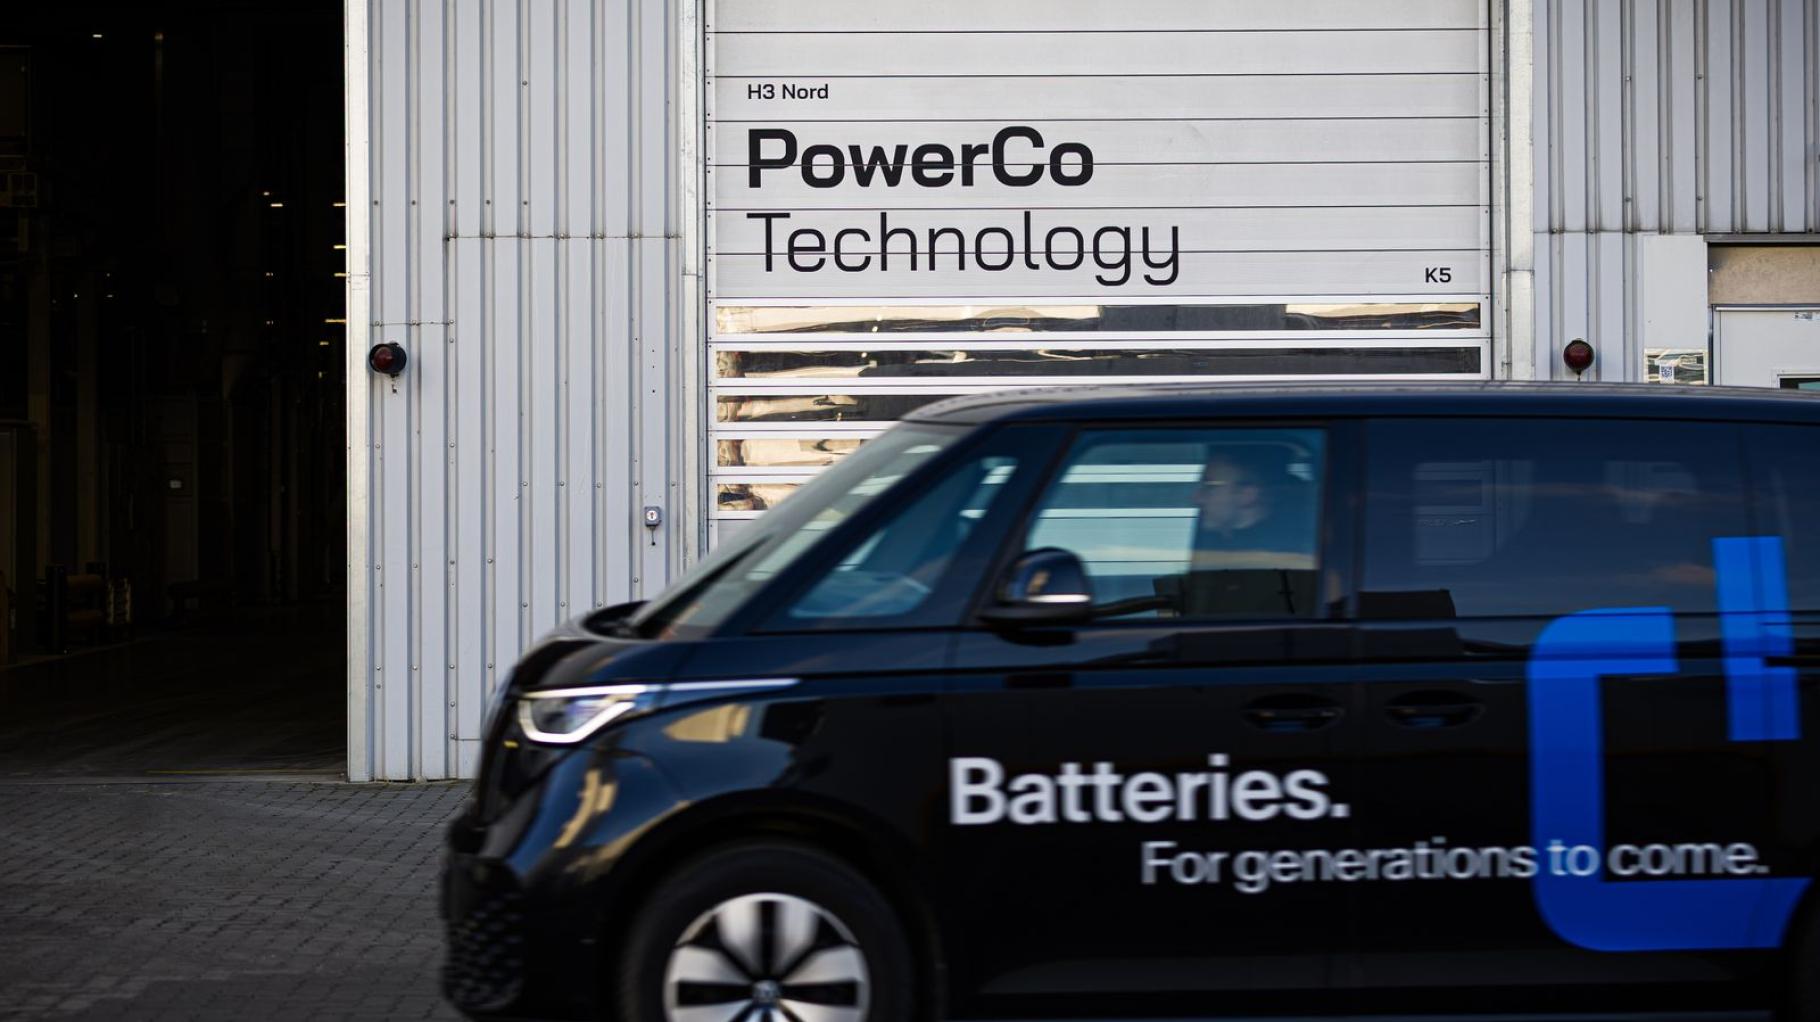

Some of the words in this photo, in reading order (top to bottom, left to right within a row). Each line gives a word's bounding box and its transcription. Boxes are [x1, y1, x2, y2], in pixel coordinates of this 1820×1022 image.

[748, 83, 776, 100] H3
[782, 83, 829, 100] Nord
[748, 126, 1094, 188] PowerCo
[746, 210, 1180, 286] Technology
[1425, 267, 1452, 284] K5
[950, 754, 1350, 826] Batteries.
[1142, 840, 1228, 885] For
[1234, 837, 1539, 894] generations
[1546, 840, 1599, 876] to
[1608, 841, 1769, 876] come.
